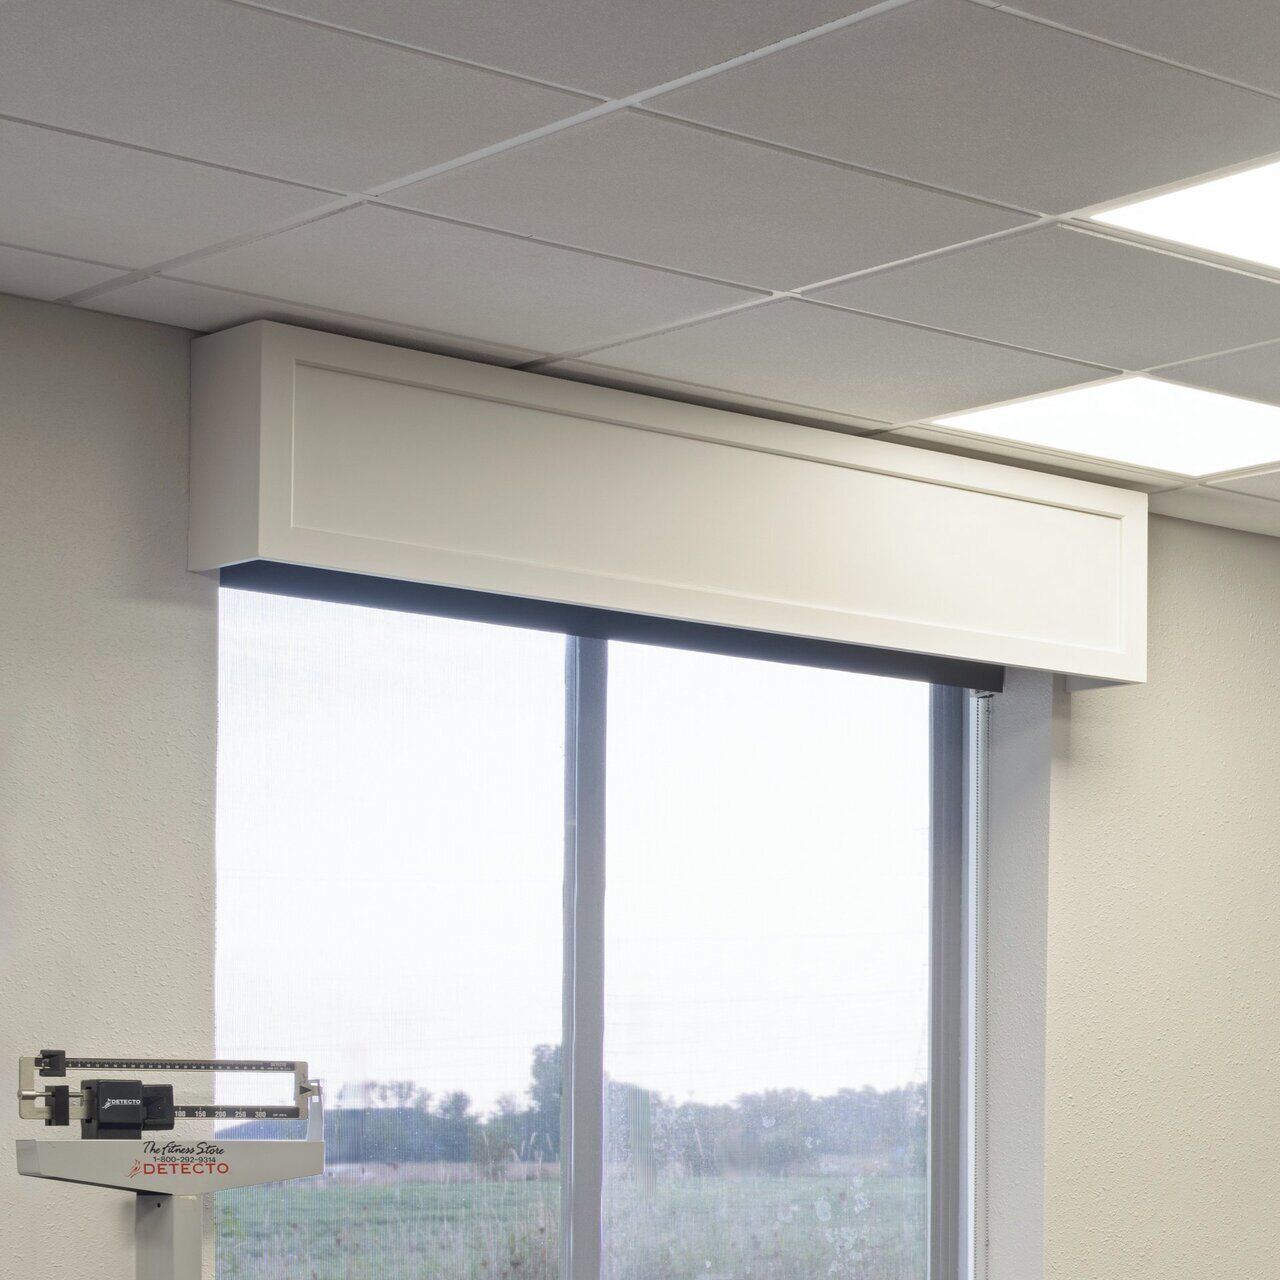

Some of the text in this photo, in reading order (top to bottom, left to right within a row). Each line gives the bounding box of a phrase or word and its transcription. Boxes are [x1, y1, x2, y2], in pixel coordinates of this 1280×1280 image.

[174, 1110, 187, 1118] 100
[194, 1110, 207, 1118] 150
[214, 1110, 227, 1119] 200
[234, 1111, 248, 1119] 250
[254, 1111, 267, 1119] 300
[143, 1140, 160, 1154] The
[196, 1141, 225, 1156] Store
[153, 1156, 217, 1164] 1-800-292-9314
[143, 1162, 229, 1175] DETECTO
